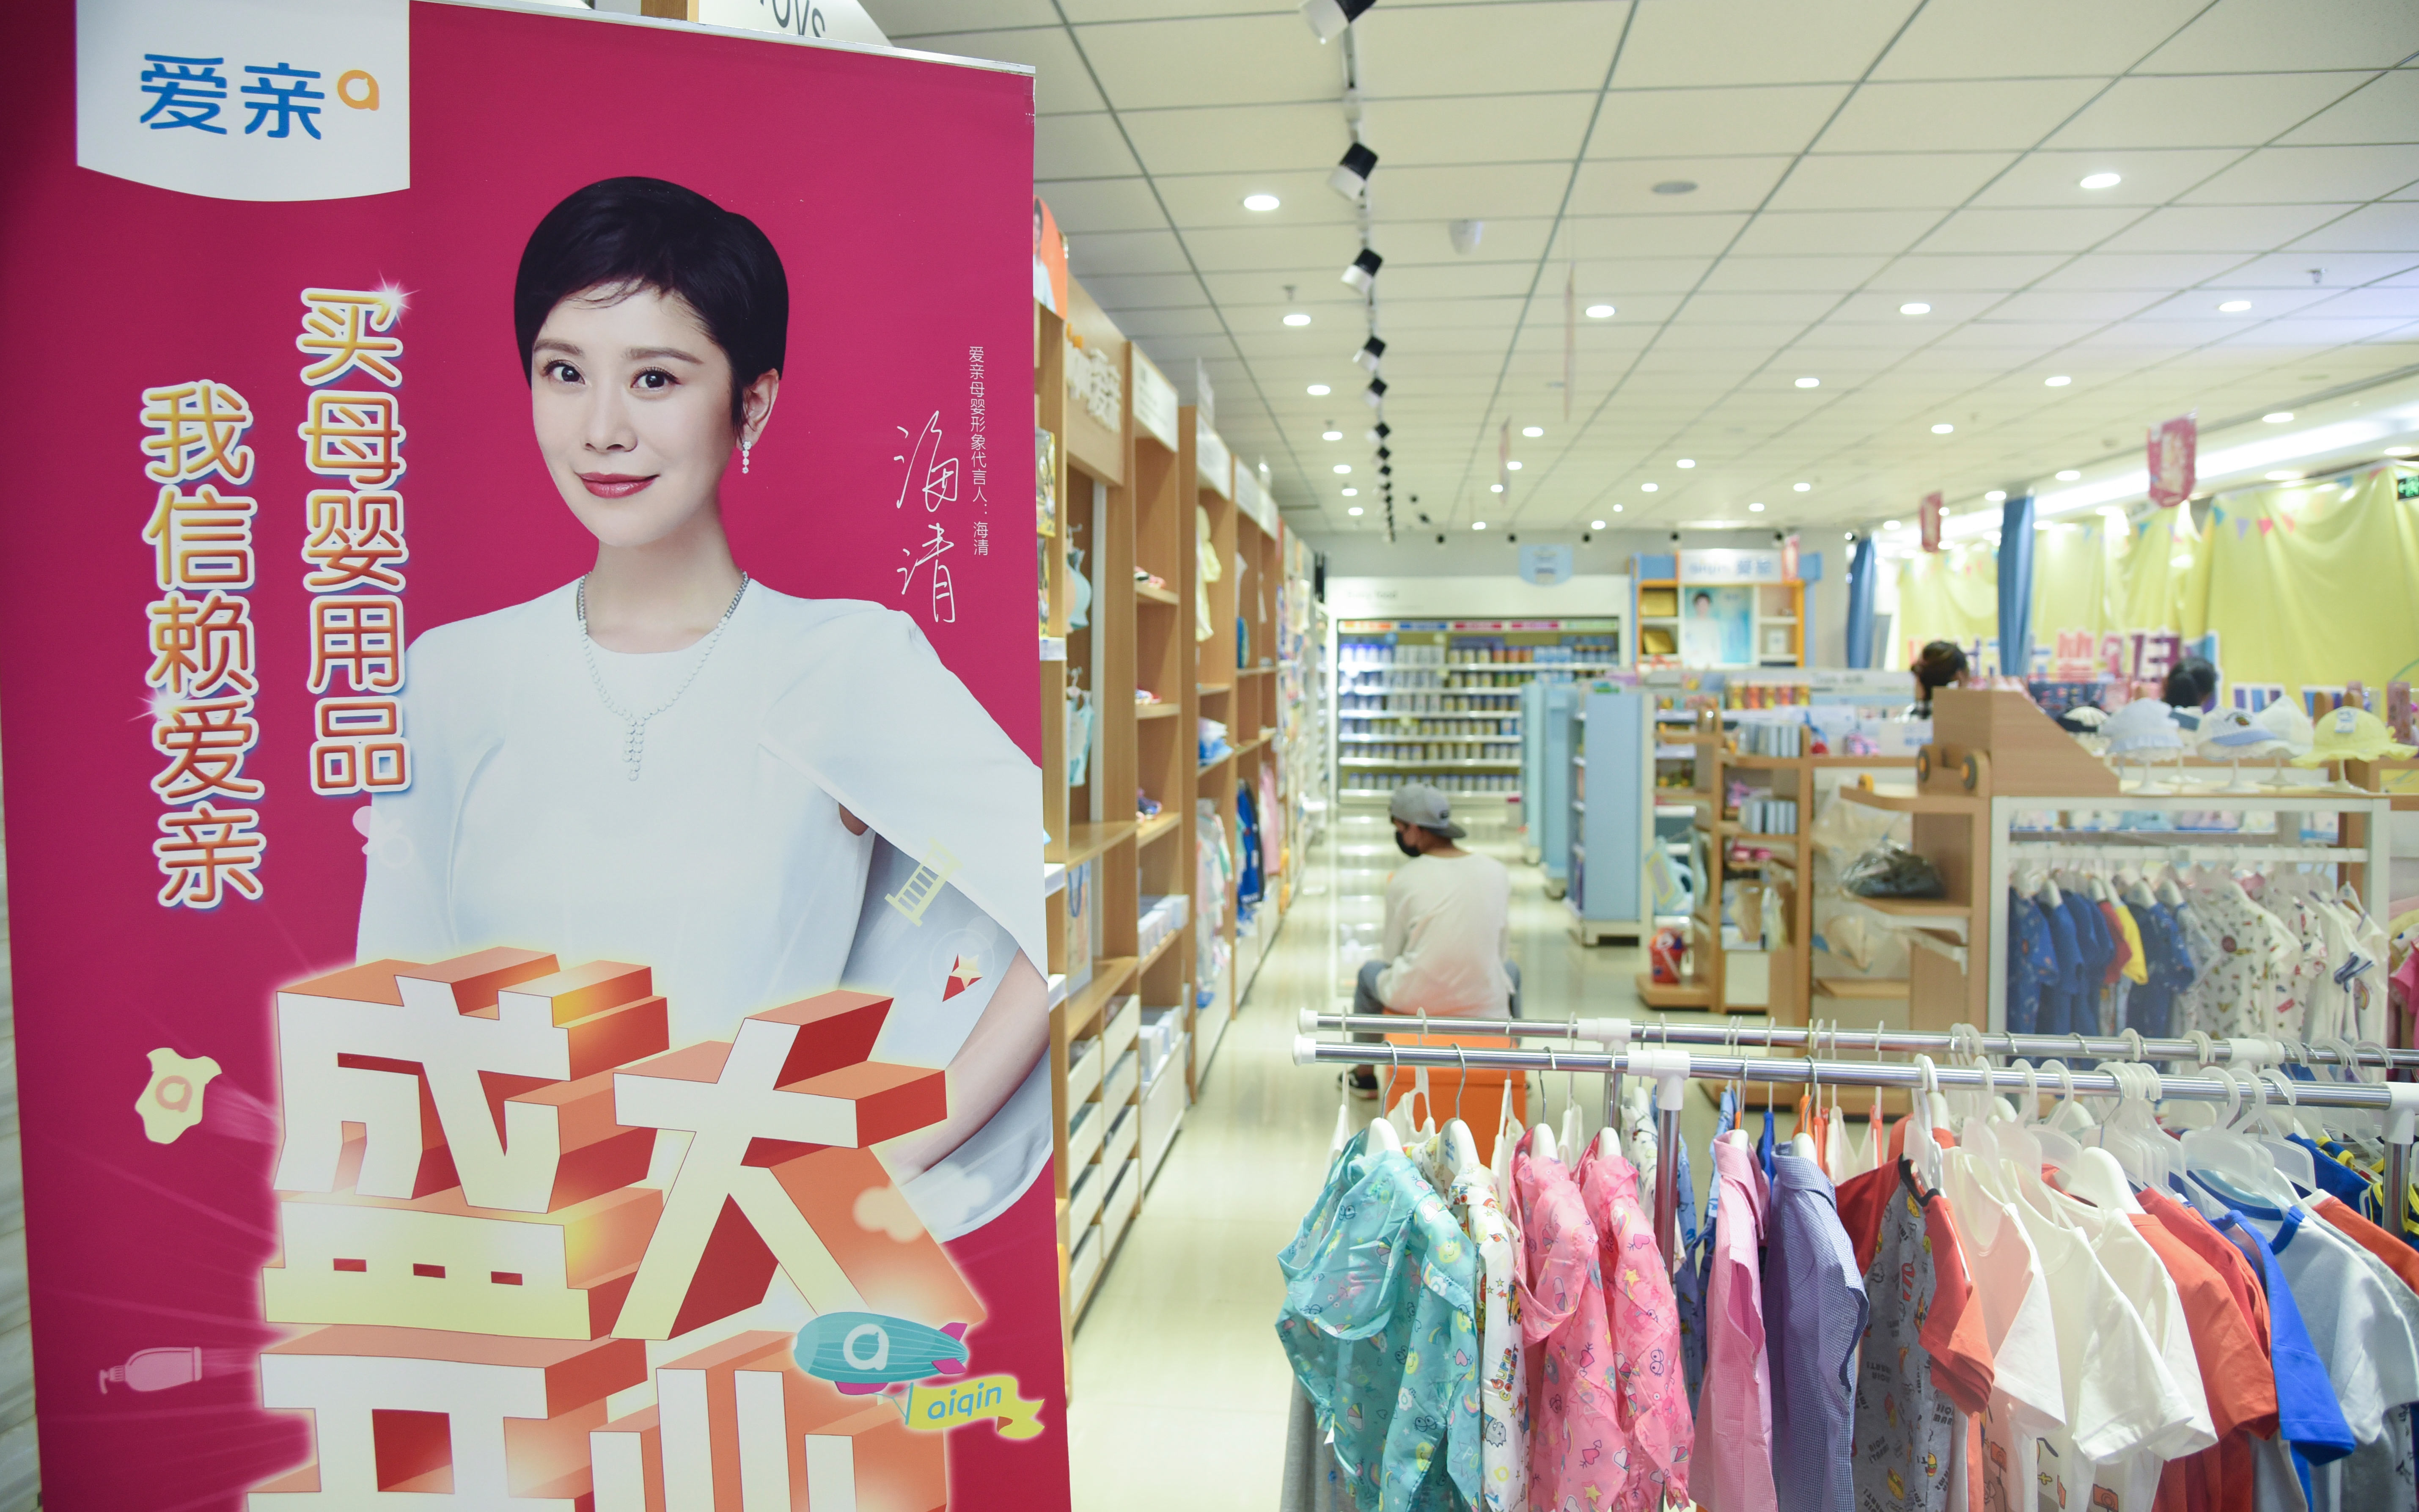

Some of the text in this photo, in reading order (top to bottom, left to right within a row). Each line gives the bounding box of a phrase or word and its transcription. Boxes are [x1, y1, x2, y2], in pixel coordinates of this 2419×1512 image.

[140, 53, 325, 140] 爱亲
[140, 379, 267, 909] 我信赖爱亲
[296, 288, 412, 795] 买母婴用品
[261, 956, 943, 1341] 盛大
[927, 1382, 1002, 1420] aiqin
